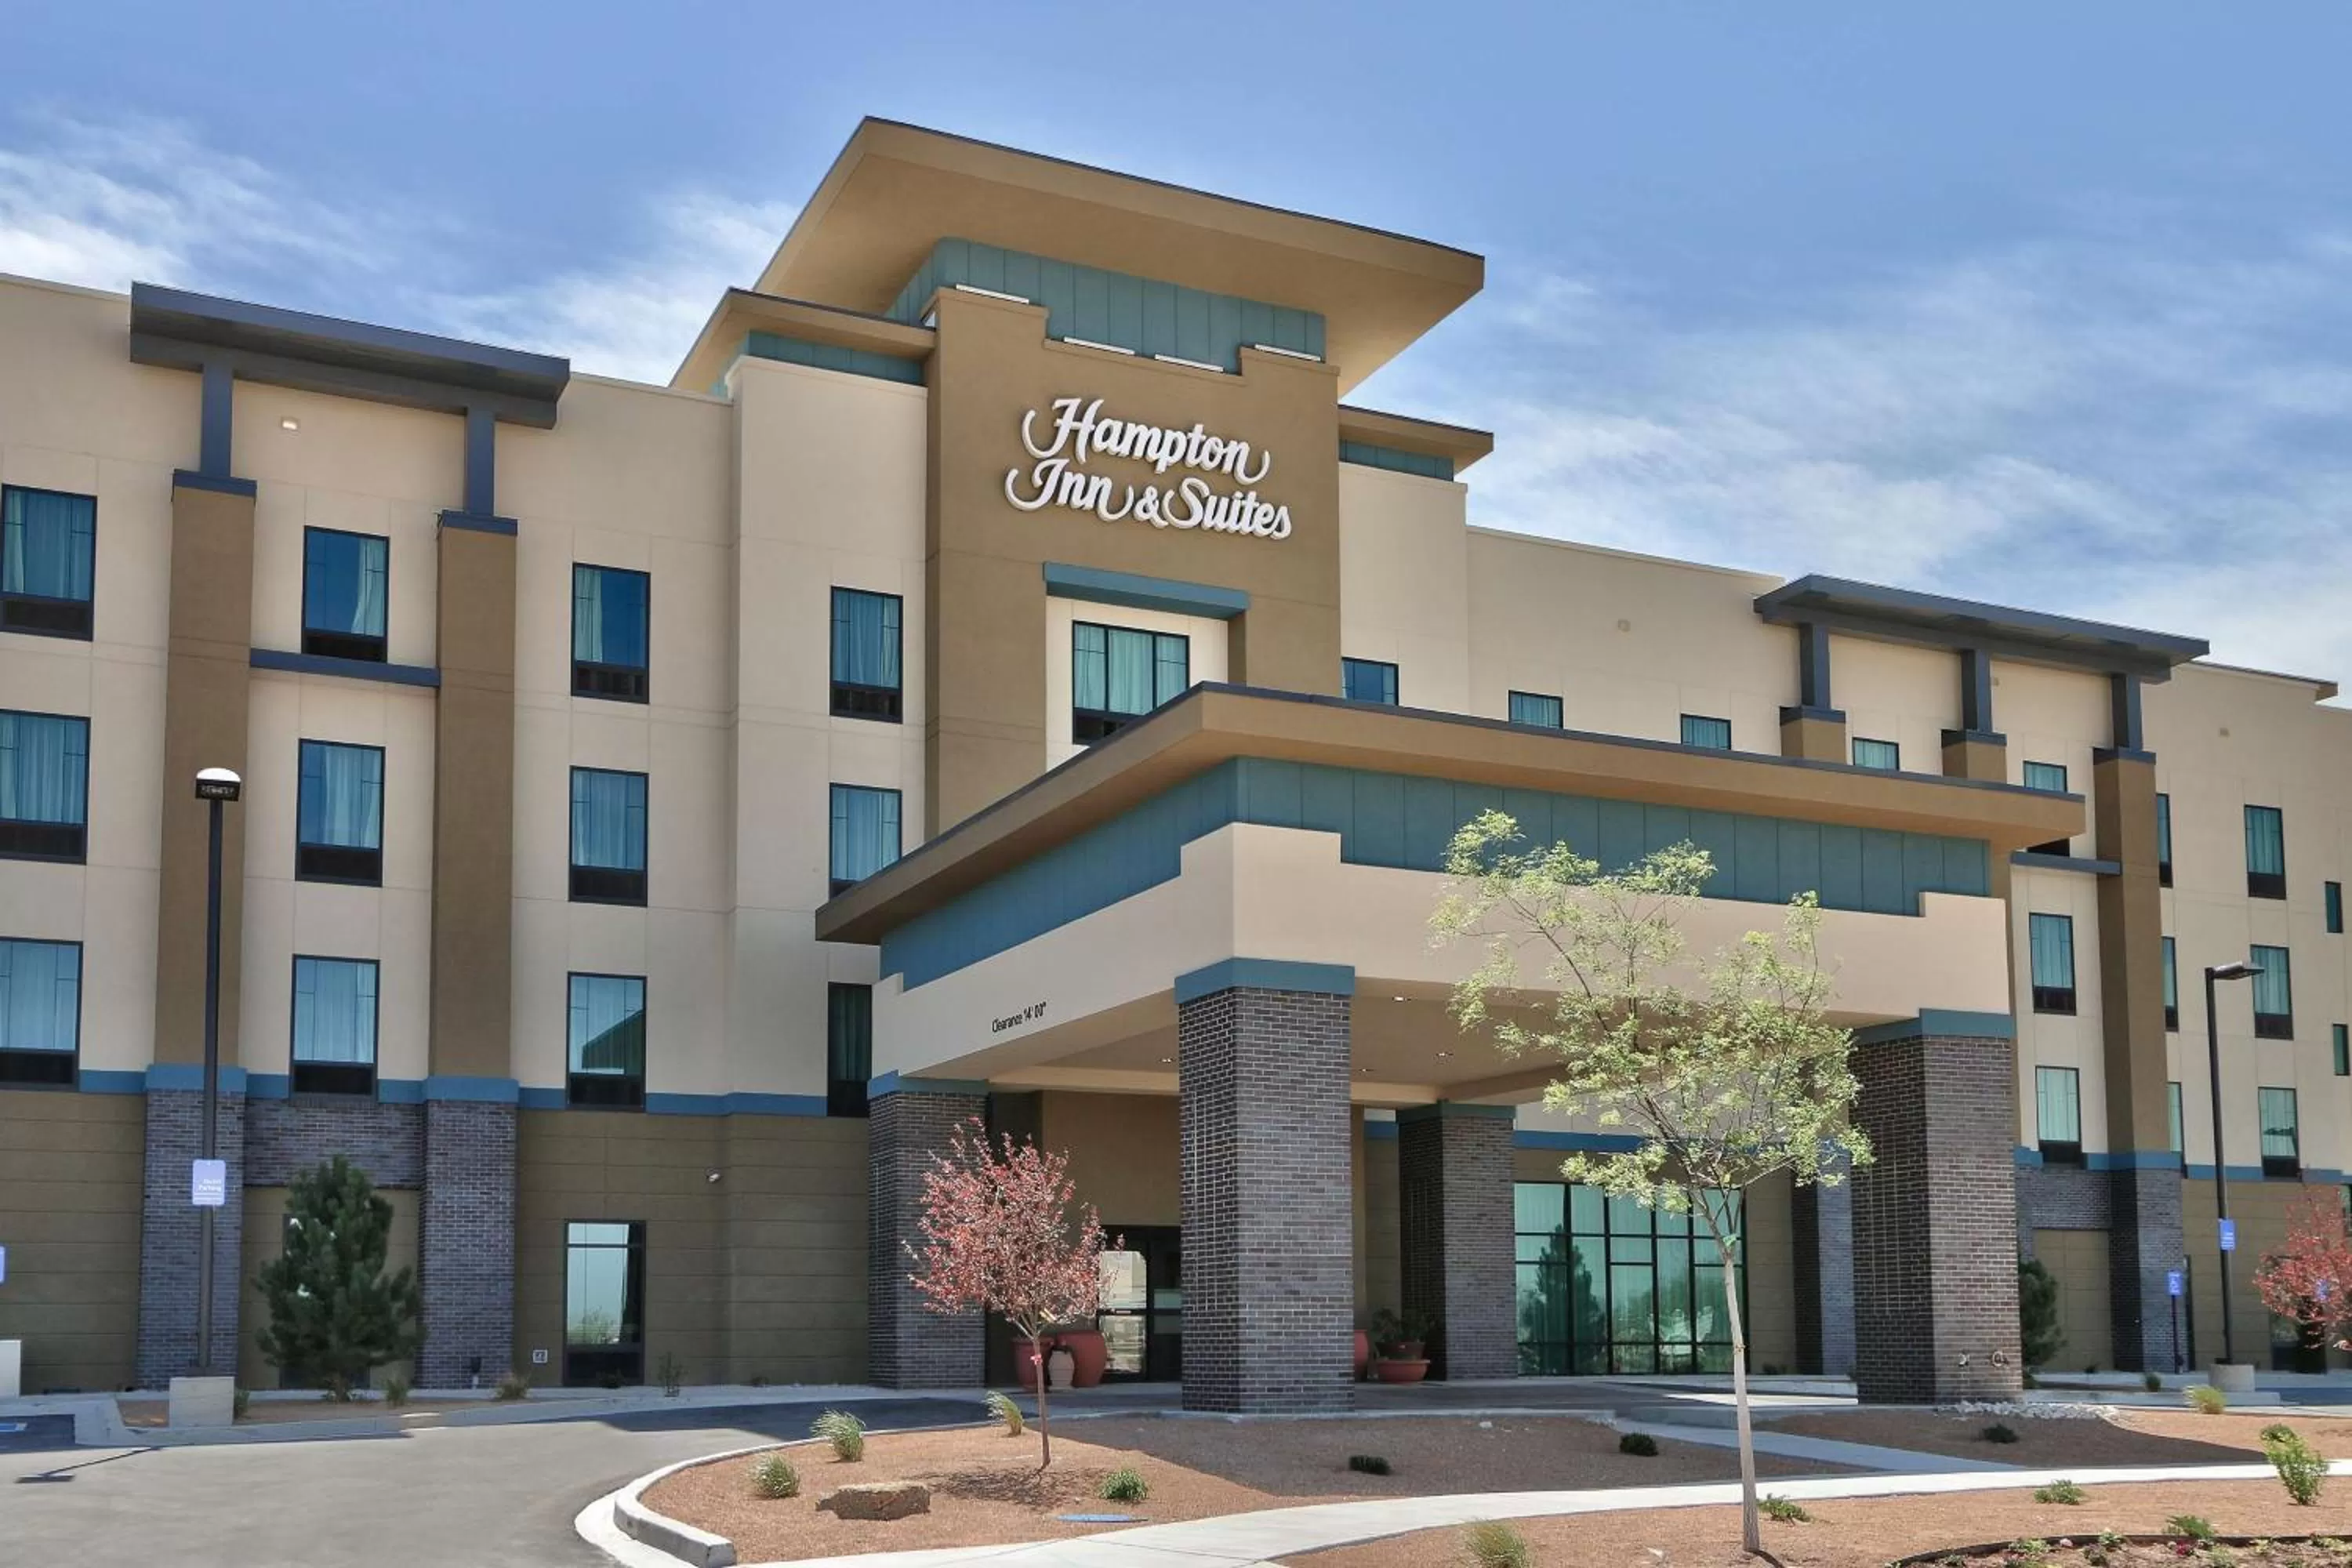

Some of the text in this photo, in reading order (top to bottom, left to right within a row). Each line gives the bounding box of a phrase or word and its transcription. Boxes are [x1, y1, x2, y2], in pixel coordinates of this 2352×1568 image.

[1022, 397, 1271, 485] Hampton
[1004, 458, 1293, 540] Inn & Suites
